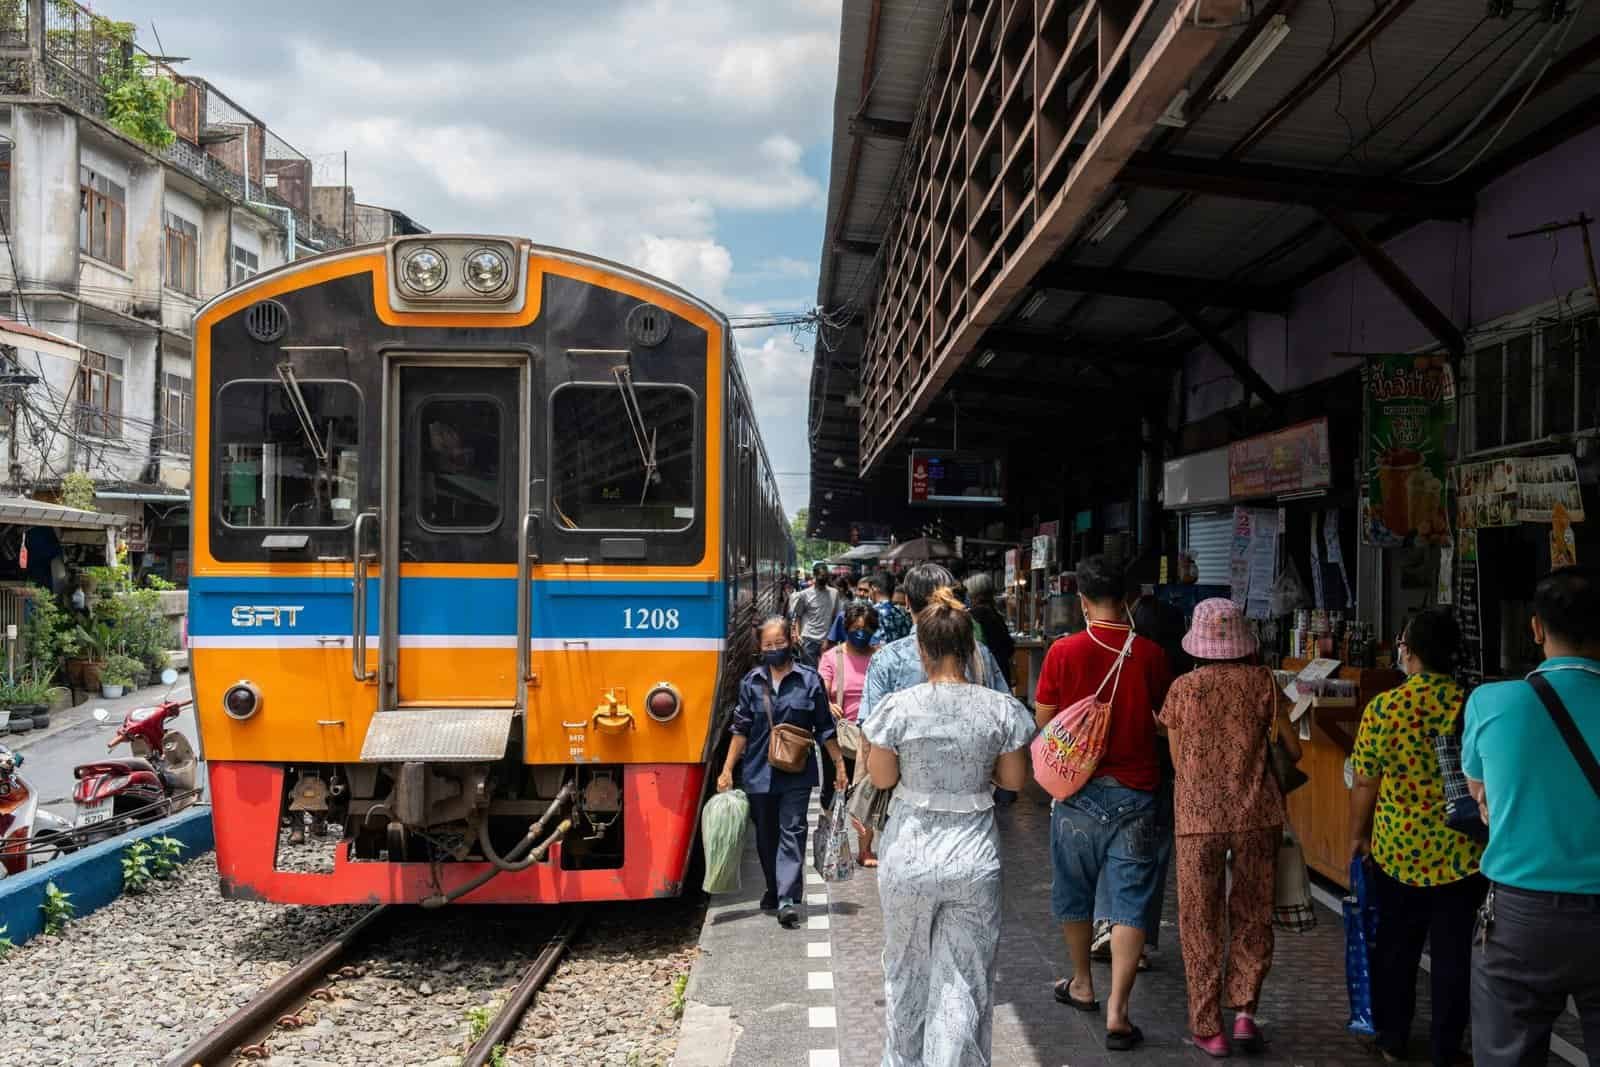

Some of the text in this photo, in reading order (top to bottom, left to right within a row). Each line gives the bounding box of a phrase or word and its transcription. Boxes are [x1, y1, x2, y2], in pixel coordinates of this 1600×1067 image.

[231, 605, 305, 627] SRT
[623, 607, 680, 631] 1208
[568, 734, 585, 745] MR
[1039, 744, 1081, 782] HEART
